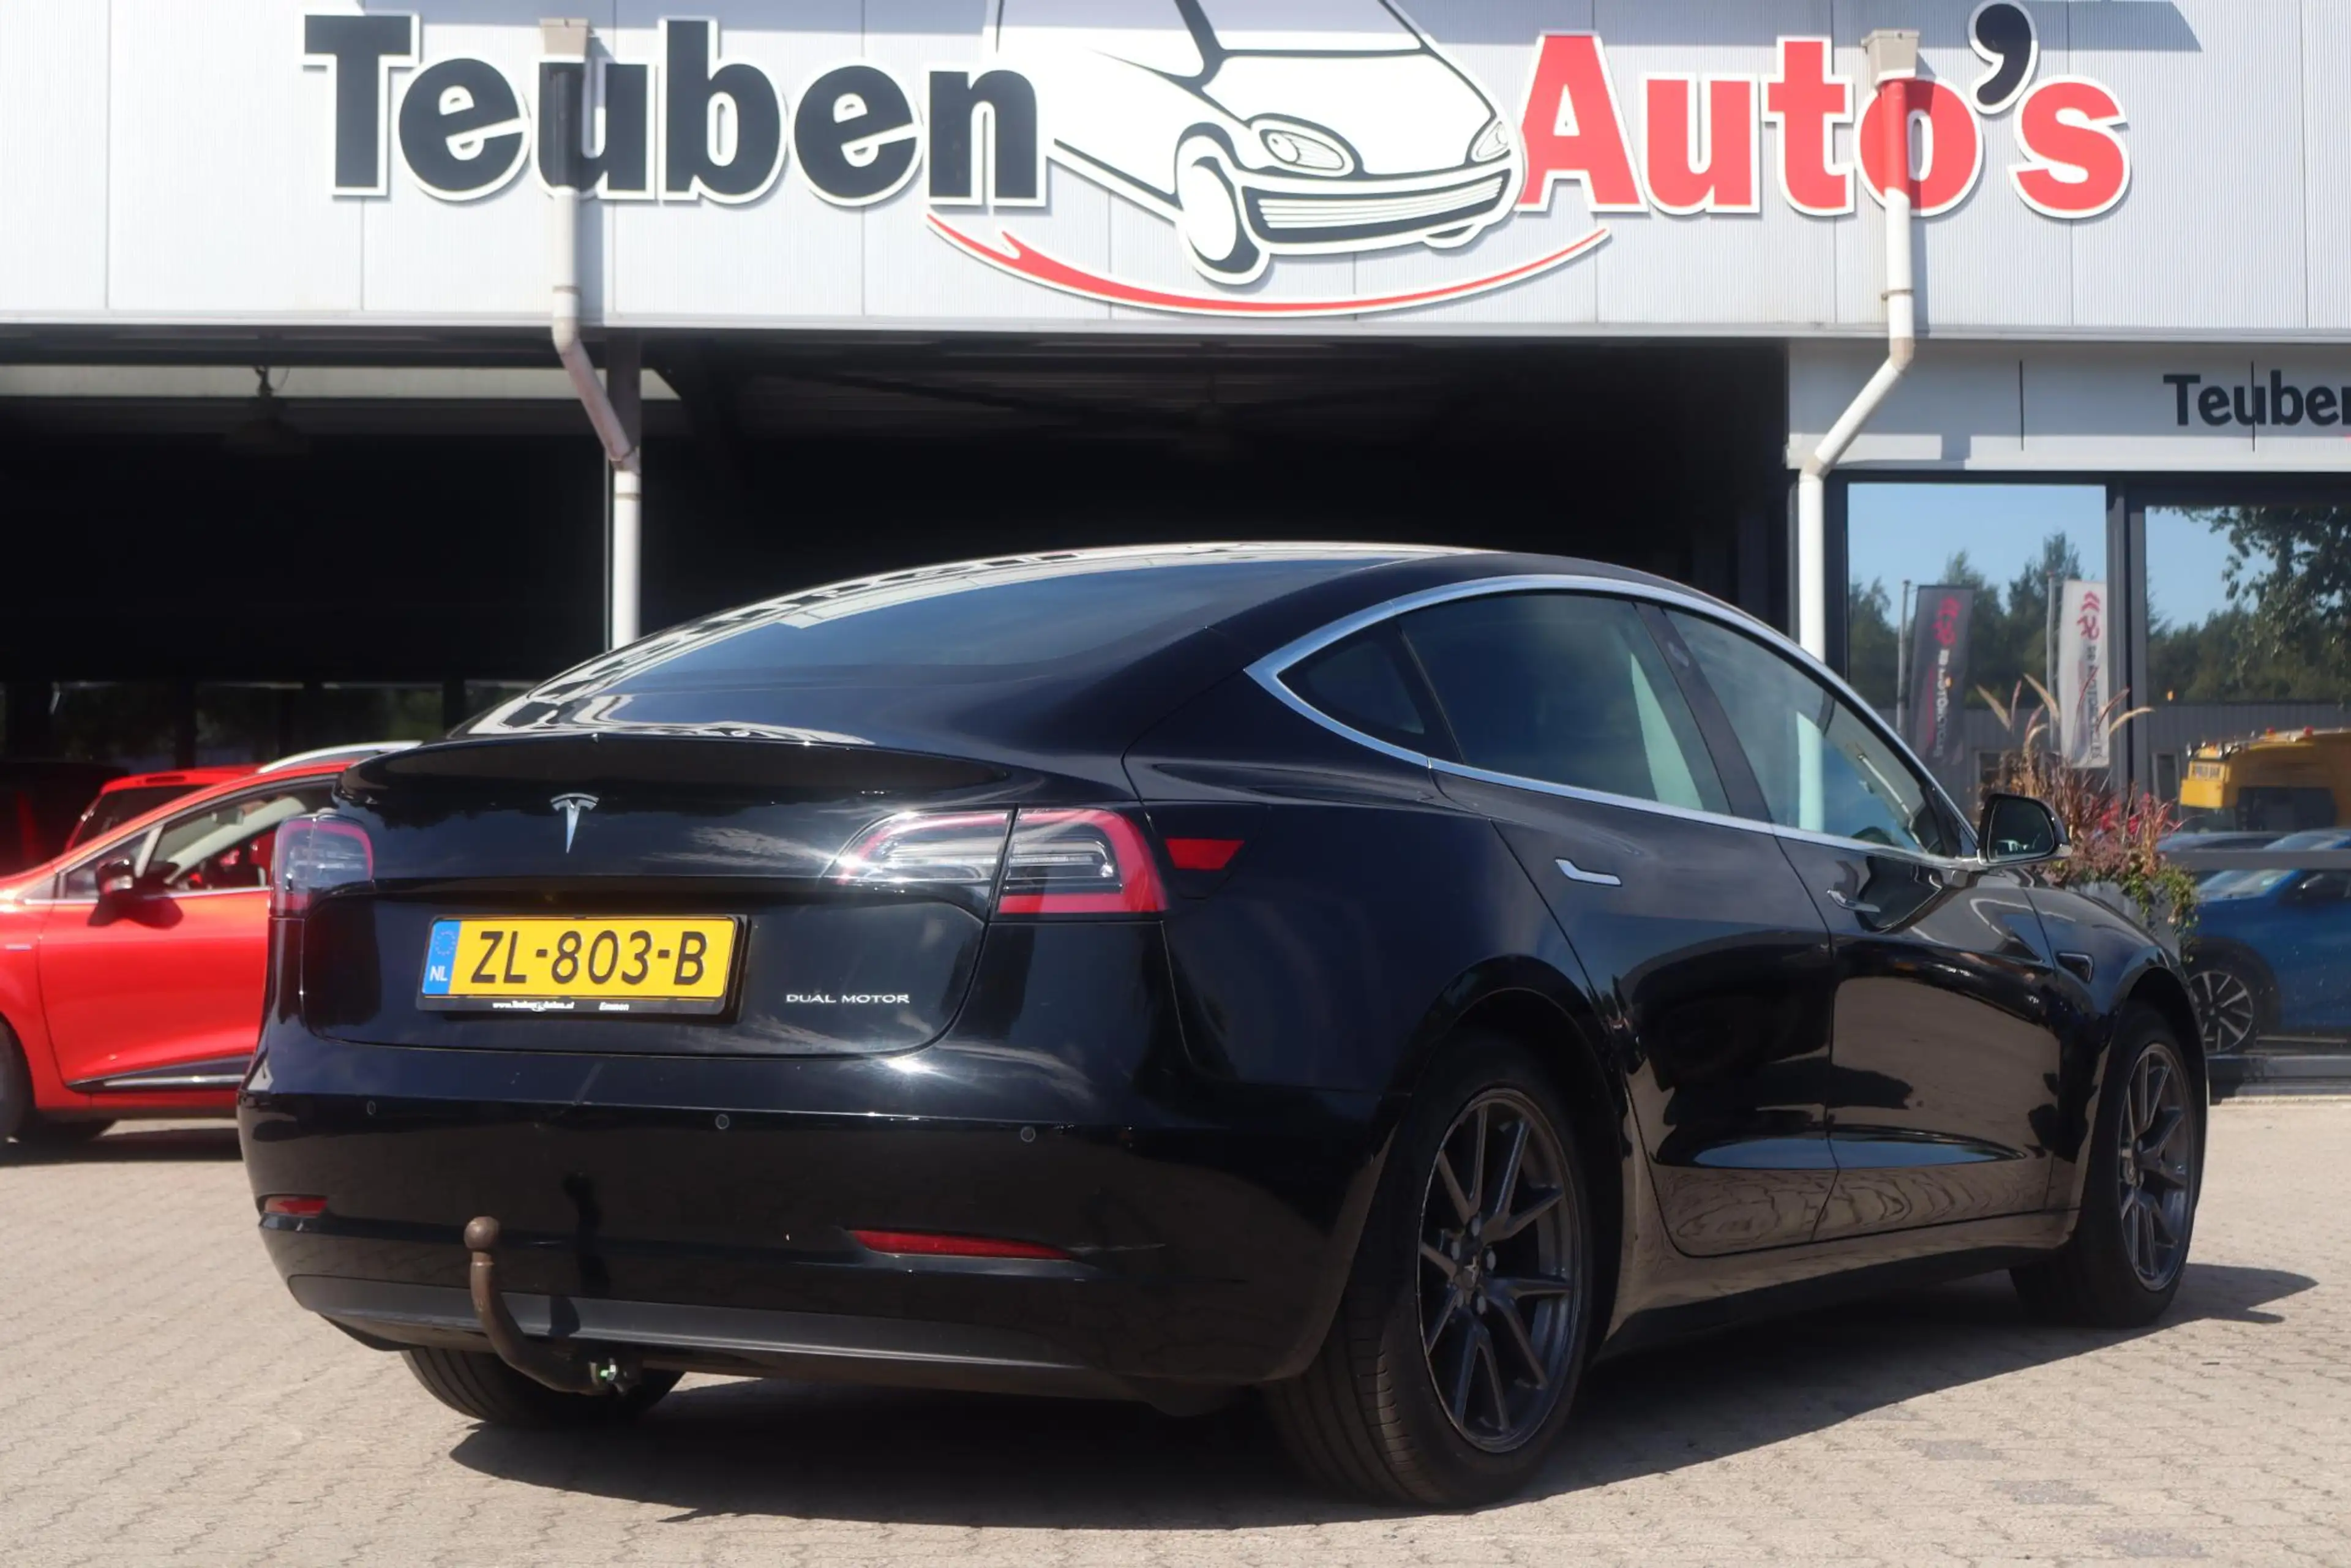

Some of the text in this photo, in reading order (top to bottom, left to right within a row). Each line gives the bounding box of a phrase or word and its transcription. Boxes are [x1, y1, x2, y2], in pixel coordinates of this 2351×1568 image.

[302, 2, 2129, 216] Teuben Auto's
[430, 966, 448, 981] NL
[471, 929, 708, 985] ZL-803-B
[786, 994, 910, 1004] DUAL MOTOR
